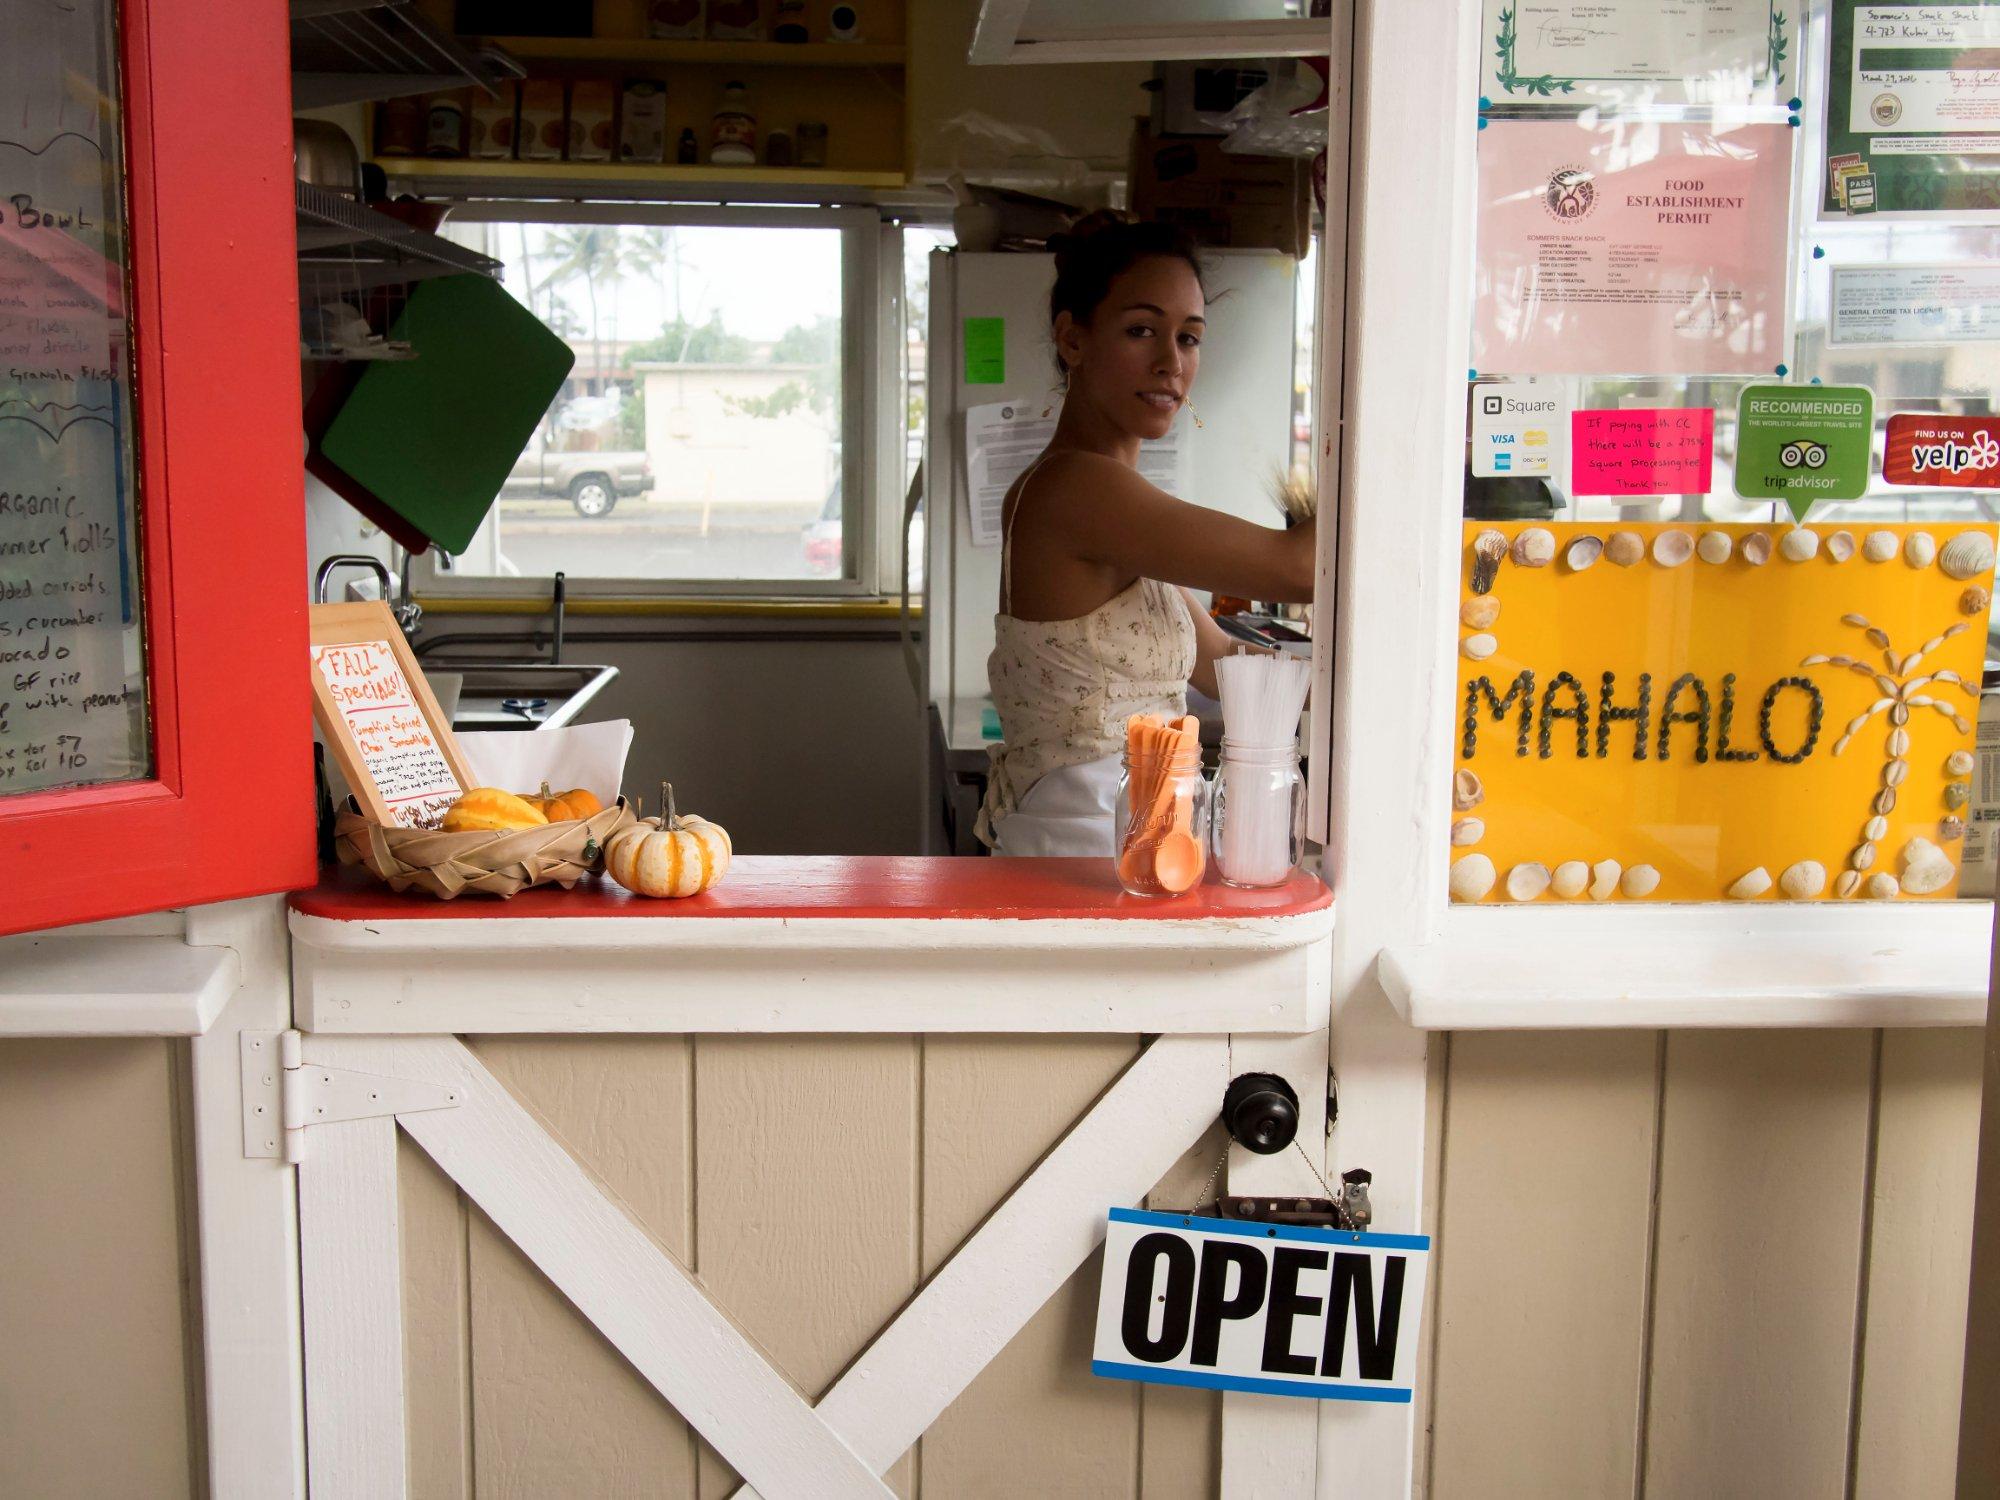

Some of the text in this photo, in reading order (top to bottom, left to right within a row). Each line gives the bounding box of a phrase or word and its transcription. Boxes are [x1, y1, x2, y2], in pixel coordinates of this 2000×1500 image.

[1919, 9, 1944, 20] Snack
[1952, 9, 1980, 21] Shack
[1665, 180, 1704, 192] FOOD
[1850, 179, 1871, 188] PASS
[1626, 196, 1745, 209] ESTABLISHMENT
[1657, 213, 1712, 225] PERMIT
[1506, 398, 1556, 414] Square
[1749, 401, 1862, 415] RECOMMENDED
[1586, 417, 1691, 433] If paying with CC
[1491, 434, 1515, 443] VISA
[1915, 430, 1964, 439] FIND US ON
[1588, 437, 1617, 450] there
[1622, 439, 1642, 449] will
[1648, 439, 1661, 449] be
[1914, 443, 1969, 472] yelp
[1616, 479, 1650, 489] Thank
[1764, 474, 1837, 490] tripadvisor
[328, 648, 380, 677] FALL
[25, 692, 73, 711] with
[81, 683, 131, 714] peanut
[1461, 668, 1824, 765] MAHALO
[349, 719, 391, 742] Pumpkin
[360, 737, 384, 756] Chai
[1121, 1232, 1407, 1381] OPEN
